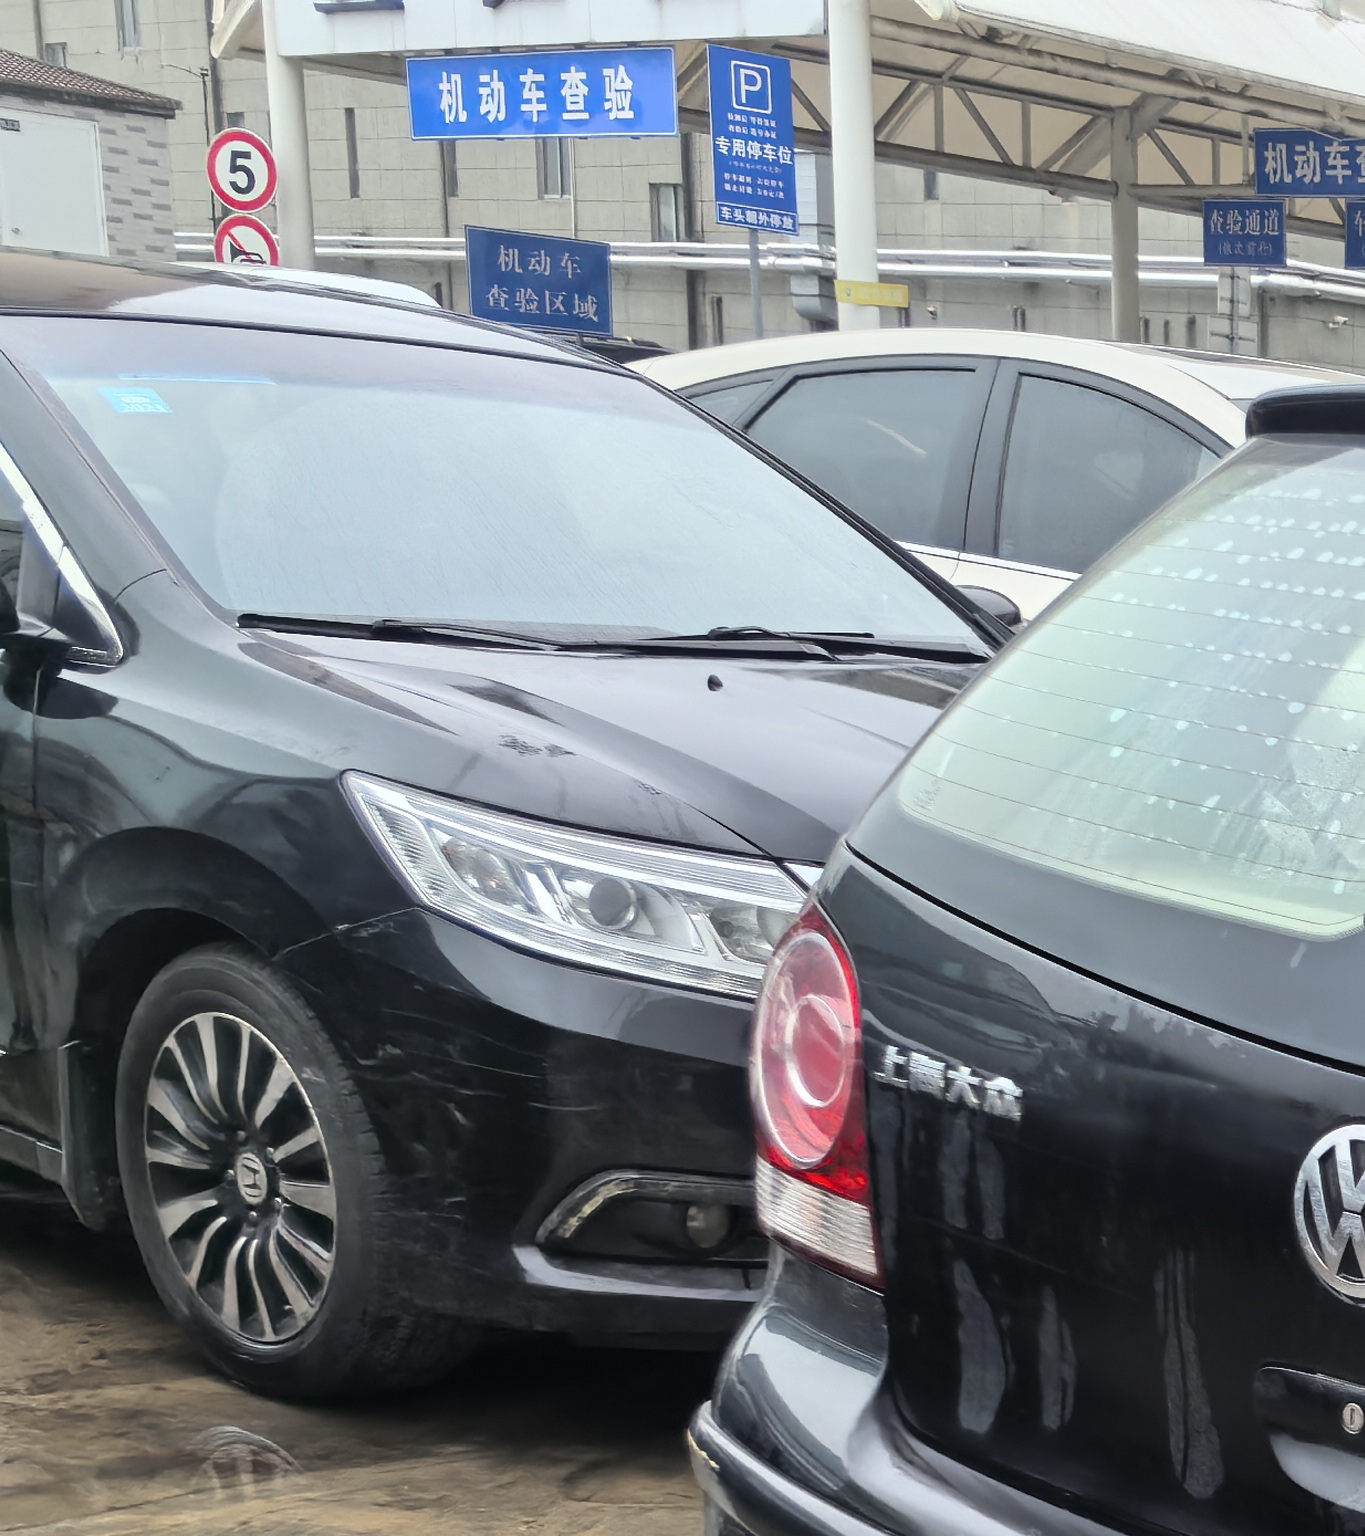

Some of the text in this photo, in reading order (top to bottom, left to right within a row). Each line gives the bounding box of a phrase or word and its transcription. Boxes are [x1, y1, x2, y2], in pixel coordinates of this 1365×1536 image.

[439, 64, 636, 125] 机动车查验
[738, 68, 763, 104] P
[714, 136, 794, 165] 专用停车位
[229, 149, 256, 195] 5
[1210, 208, 1280, 236] 查验通道
[497, 244, 583, 279] 机动车
[486, 284, 600, 324] 查验区域
